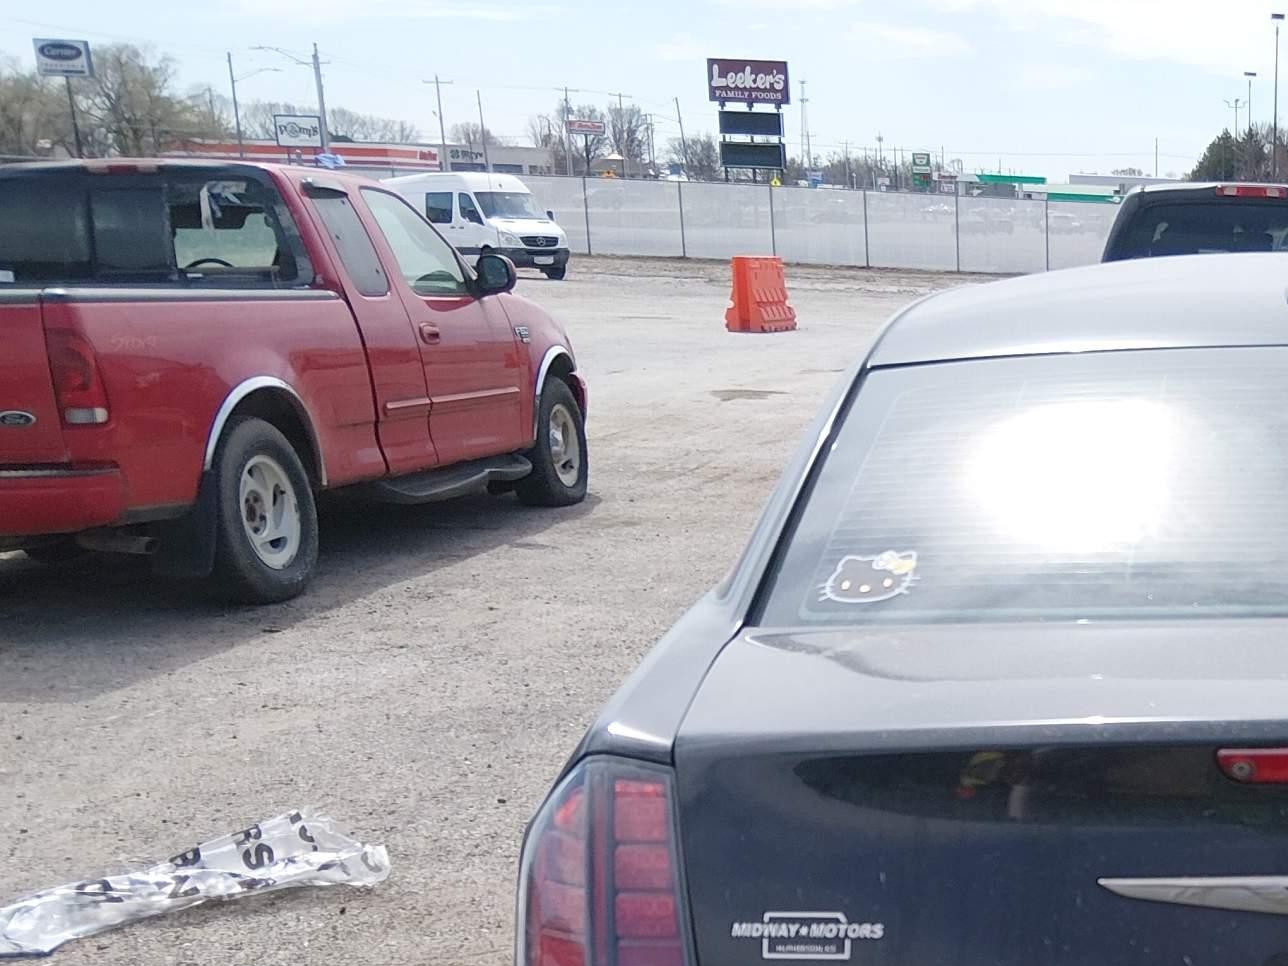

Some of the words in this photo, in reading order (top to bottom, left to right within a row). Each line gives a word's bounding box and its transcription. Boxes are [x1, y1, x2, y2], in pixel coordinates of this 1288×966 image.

[711, 63, 785, 90] Leeker's
[715, 89, 750, 98] FAMILY
[751, 91, 782, 100] FOODS
[731, 922, 799, 938] MIDWAY
[809, 922, 885, 939] MOTORS
